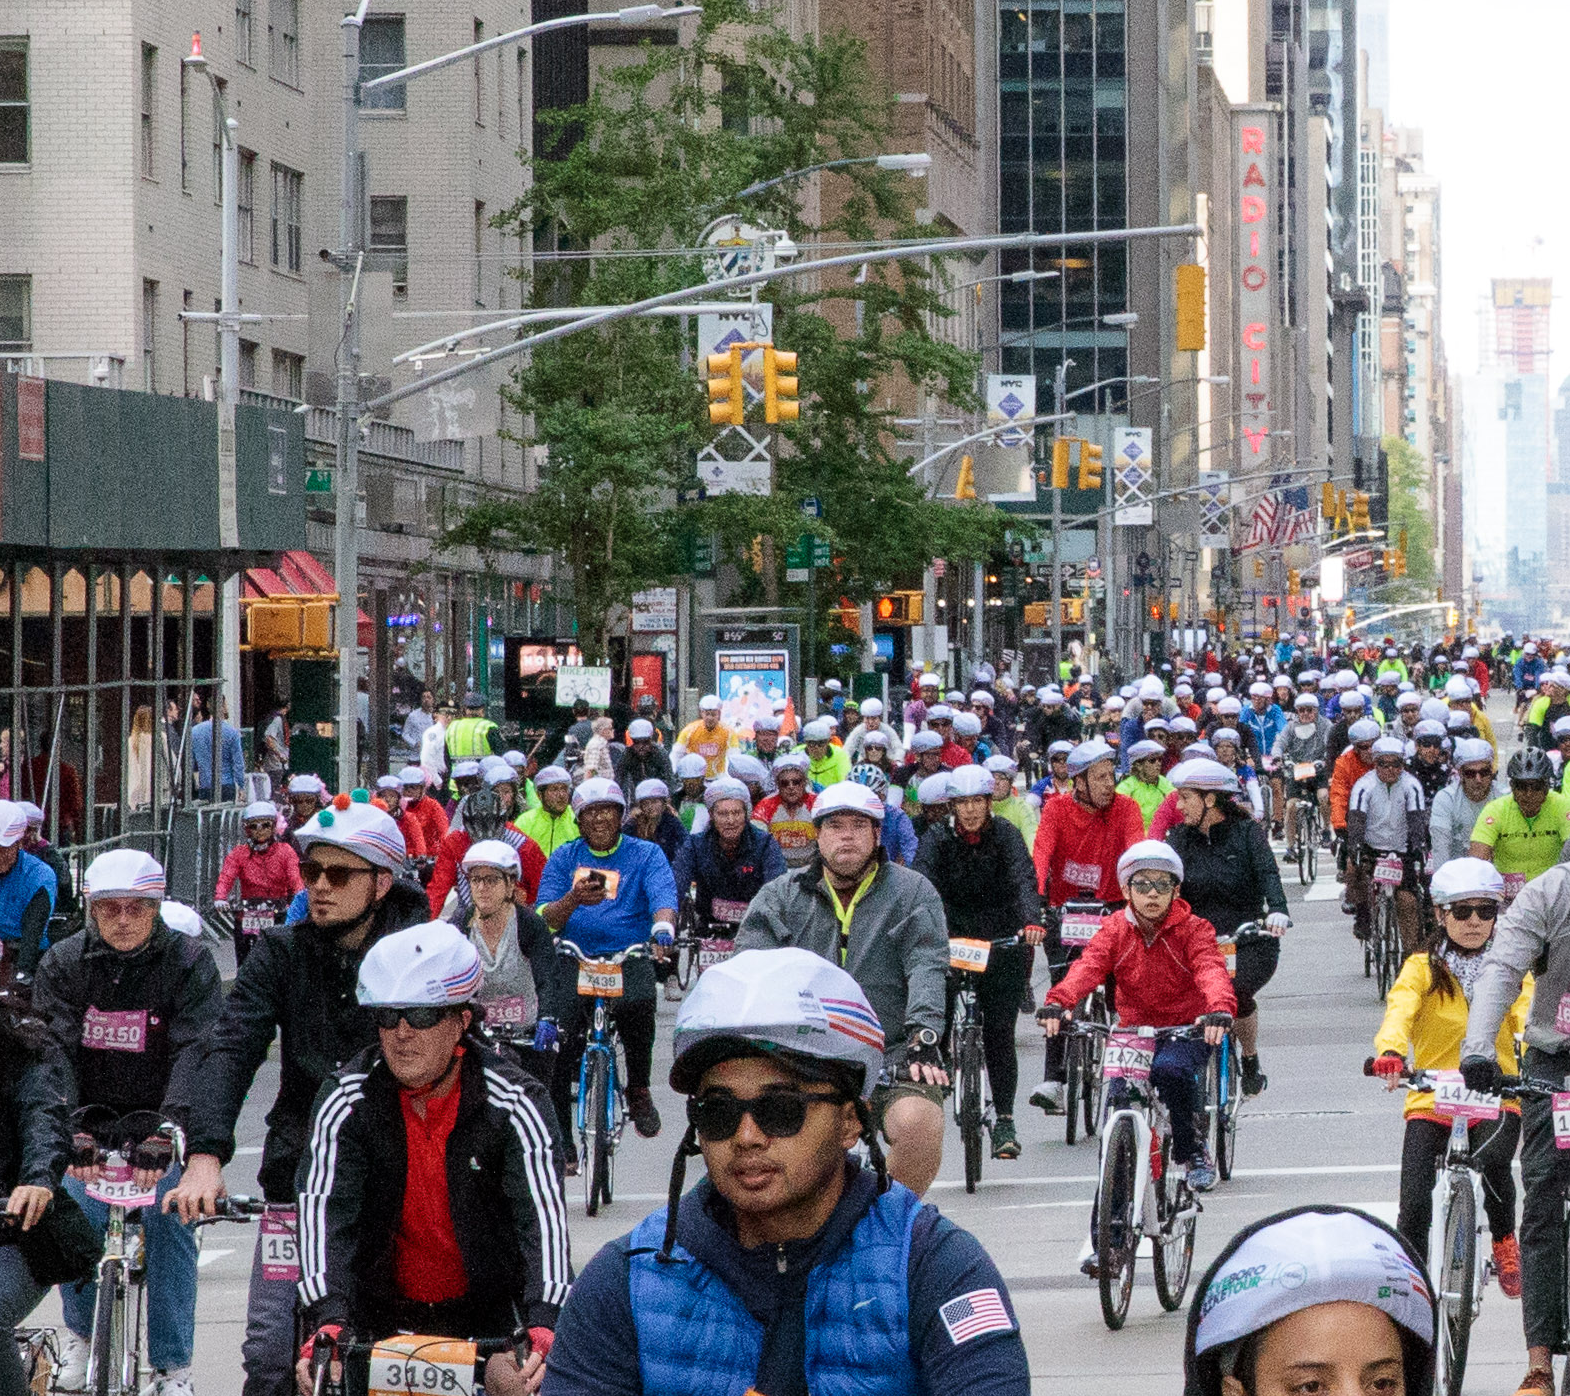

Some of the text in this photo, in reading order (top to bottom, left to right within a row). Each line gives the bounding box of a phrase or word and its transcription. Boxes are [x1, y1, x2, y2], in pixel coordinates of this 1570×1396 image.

[1241, 126, 1266, 293] RADIO
[1241, 322, 1268, 455] CITY
[1064, 923, 1100, 938] 1243
[82, 1023, 141, 1045] 19150
[384, 1363, 458, 1392] 3198
